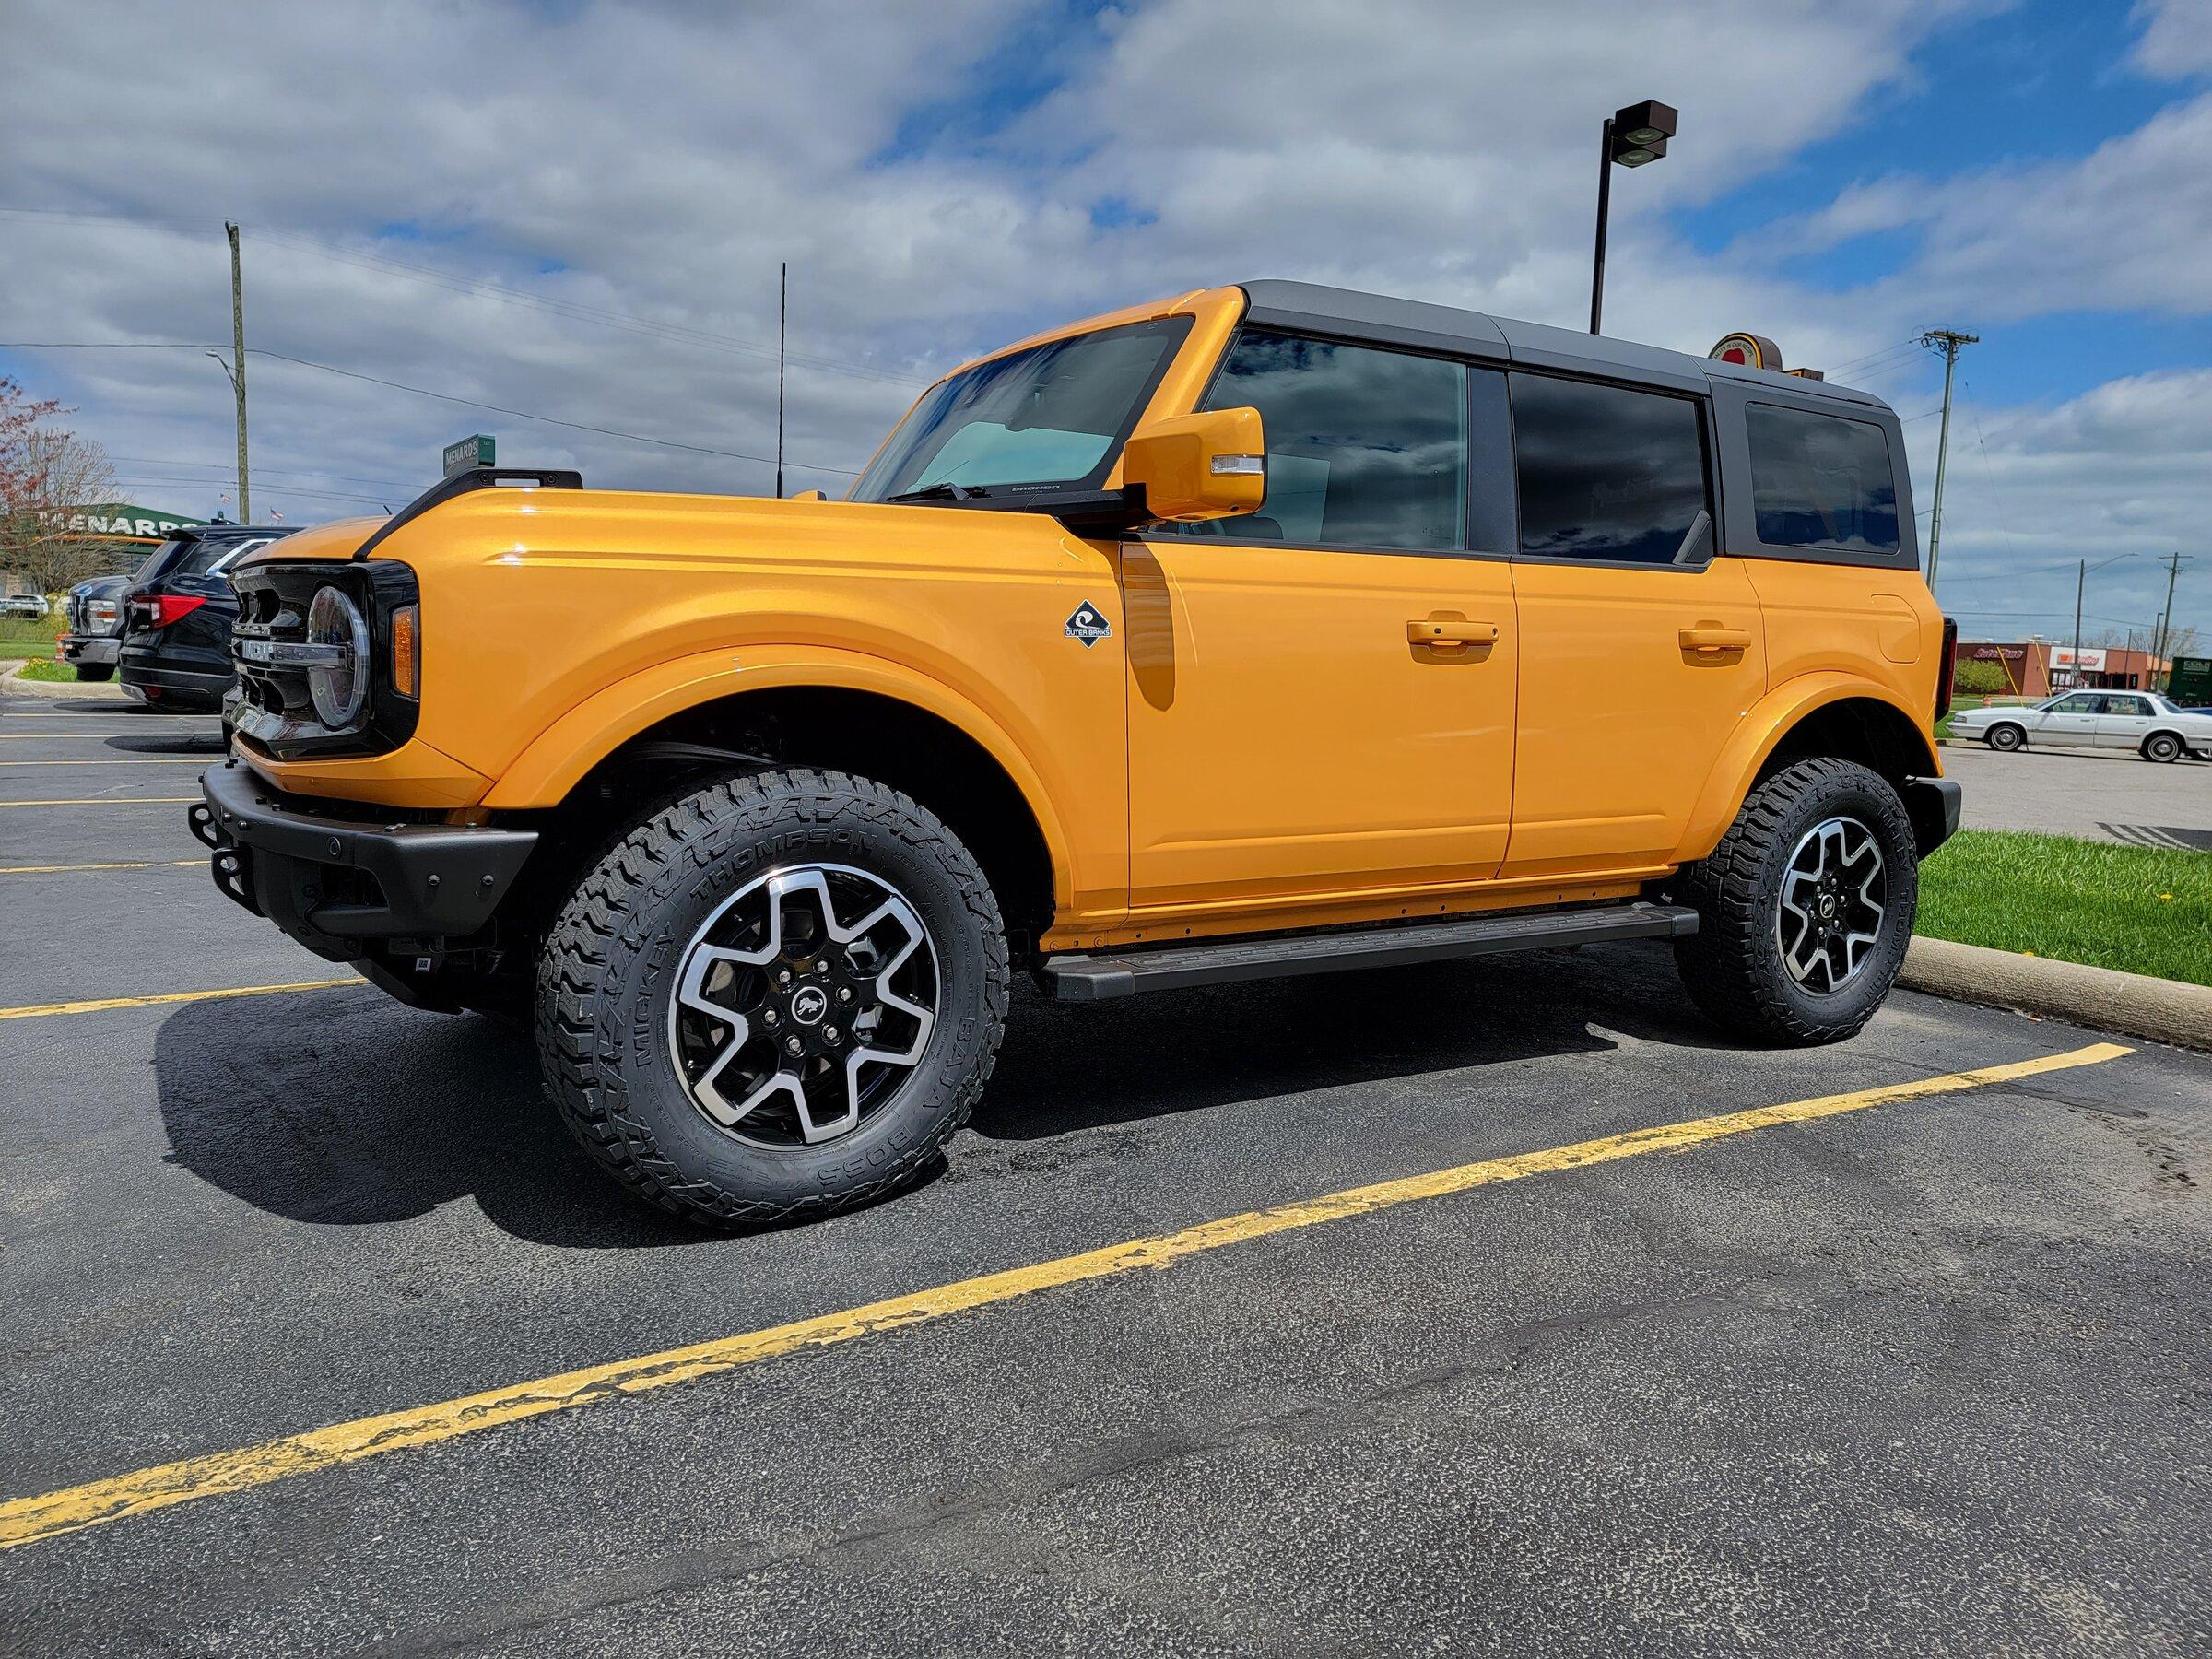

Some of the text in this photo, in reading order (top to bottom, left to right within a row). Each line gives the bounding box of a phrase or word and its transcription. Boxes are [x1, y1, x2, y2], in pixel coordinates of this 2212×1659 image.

[445, 441, 477, 466] MENARDS
[39, 512, 198, 537] MENARD
[634, 828, 877, 1068] MICKEY THOMPSON
[817, 1016, 976, 1187] BAJA BOSS
